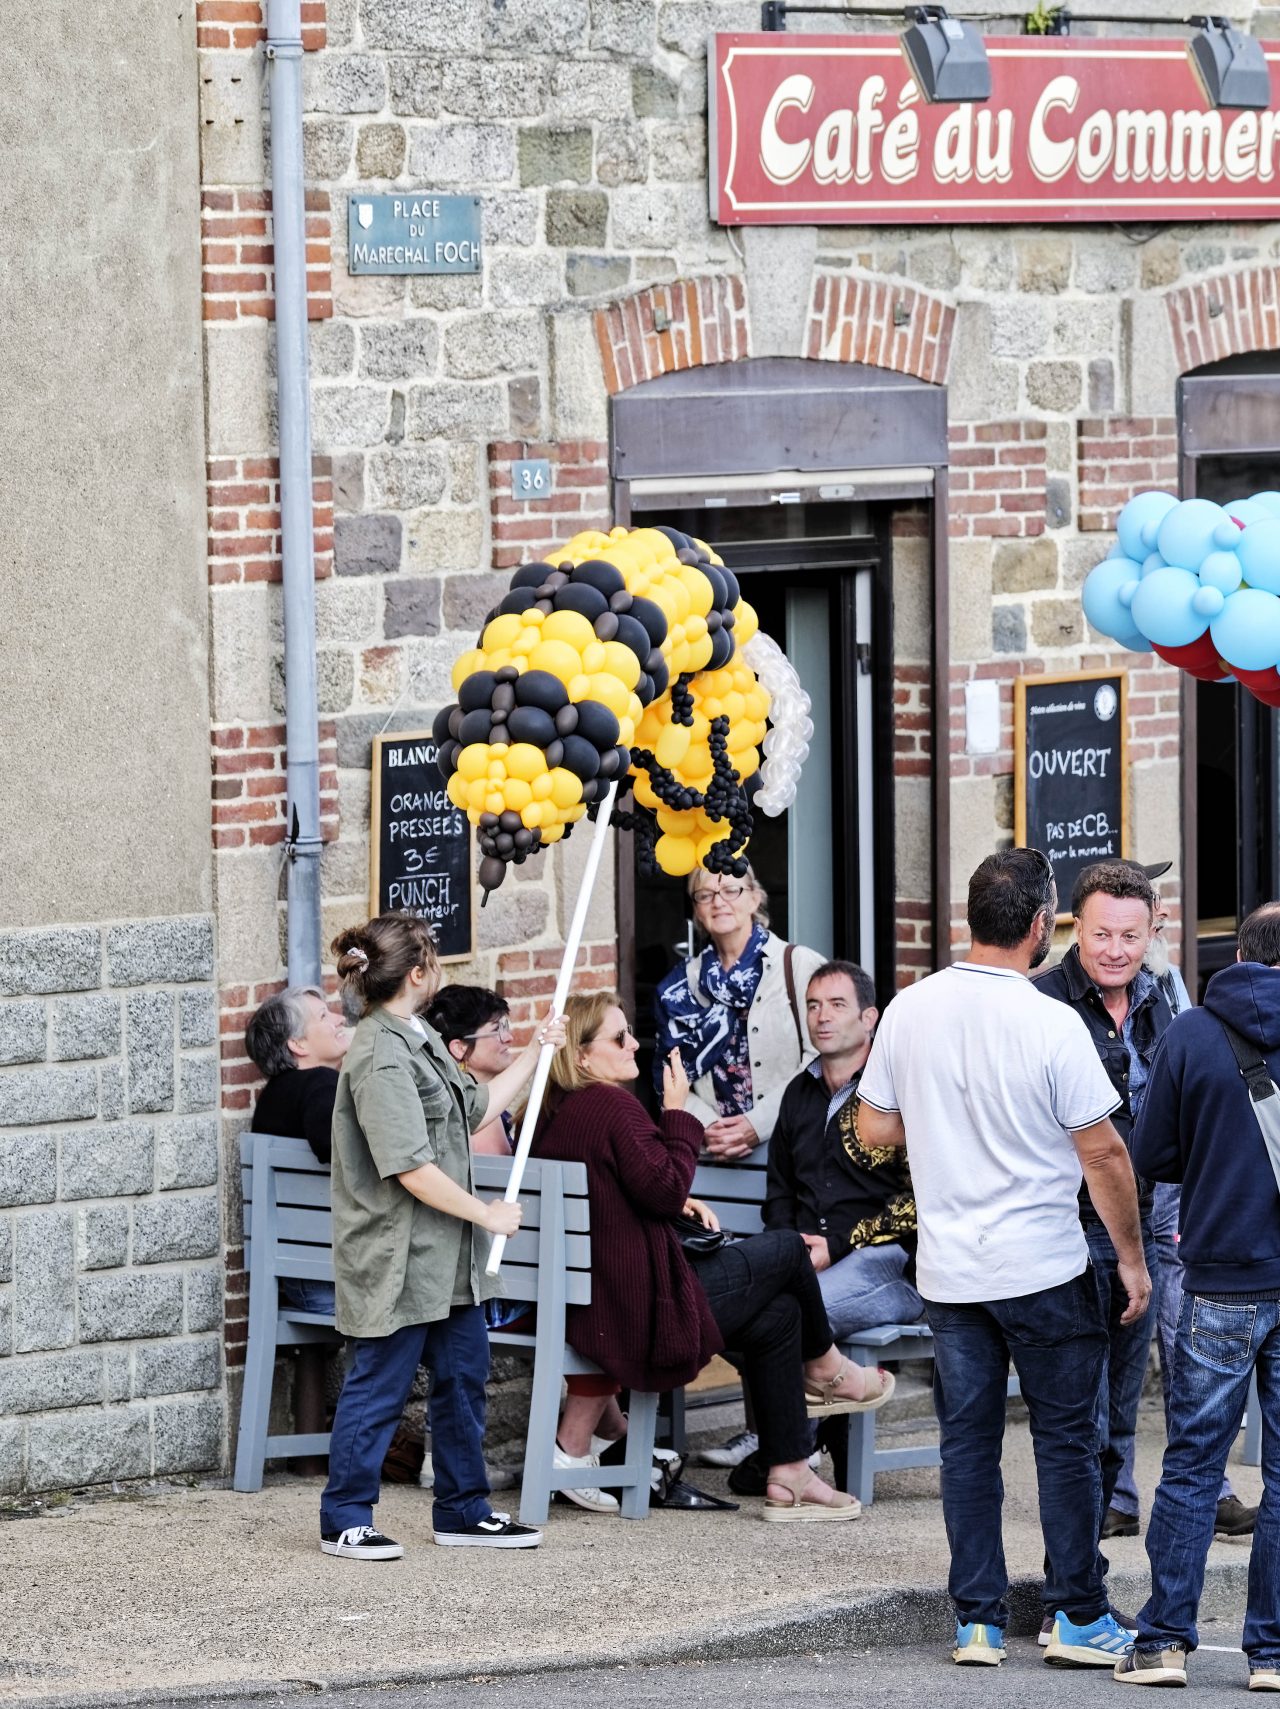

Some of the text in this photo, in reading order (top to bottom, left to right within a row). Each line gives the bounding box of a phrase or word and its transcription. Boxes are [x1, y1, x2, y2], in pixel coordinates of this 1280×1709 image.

[759, 73, 920, 185] Café
[932, 102, 1014, 184] du
[393, 200, 440, 218] PLACE
[409, 223, 425, 238] DU
[435, 240, 480, 264] FOCH
[521, 468, 544, 491] 36
[1029, 747, 1112, 779] OUVERT
[390, 790, 458, 813] ORANGE
[1046, 822, 1065, 843] PAS
[1067, 818, 1083, 839] DE
[403, 846, 442, 872] 3€
[1077, 839, 1114, 857] moment
[388, 877, 451, 909] PUNCH
